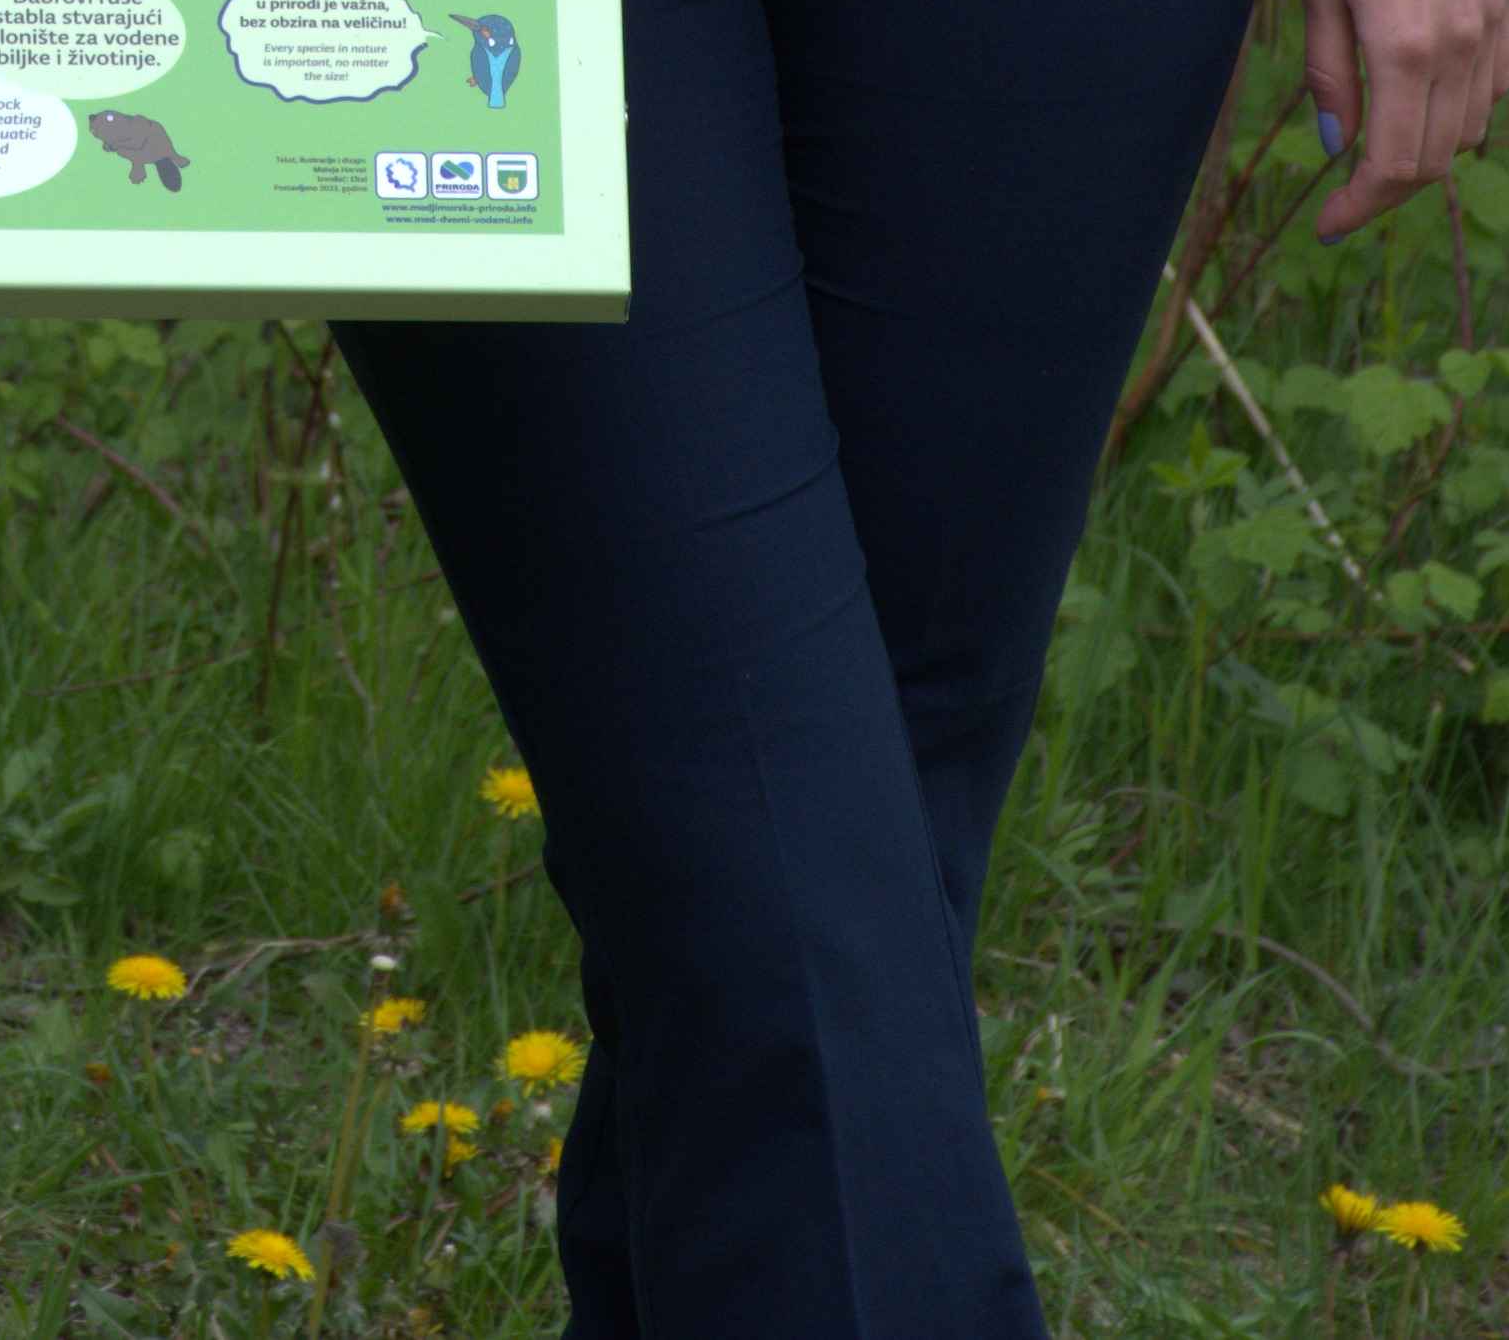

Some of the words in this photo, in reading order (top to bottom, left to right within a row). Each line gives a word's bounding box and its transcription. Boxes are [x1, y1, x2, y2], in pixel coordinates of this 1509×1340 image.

[256, 1, 266, 10] u
[62, 8, 162, 30] stvarajući
[240, 15, 267, 28] bez
[270, 15, 318, 29] obzira
[321, 19, 341, 29] na
[343, 16, 407, 29] veličinu!
[75, 33, 98, 46] za
[104, 28, 180, 46] vodene
[264, 43, 295, 55] Every
[297, 43, 336, 56] species
[338, 43, 349, 53] in
[350, 44, 388, 54] nature
[56, 49, 62, 66] i
[68, 49, 161, 70] životinje.
[263, 57, 272, 67] is
[274, 57, 332, 69] important,
[351, 58, 390, 68] matter
[304, 71, 323, 81] the
[324, 71, 349, 81] size!
